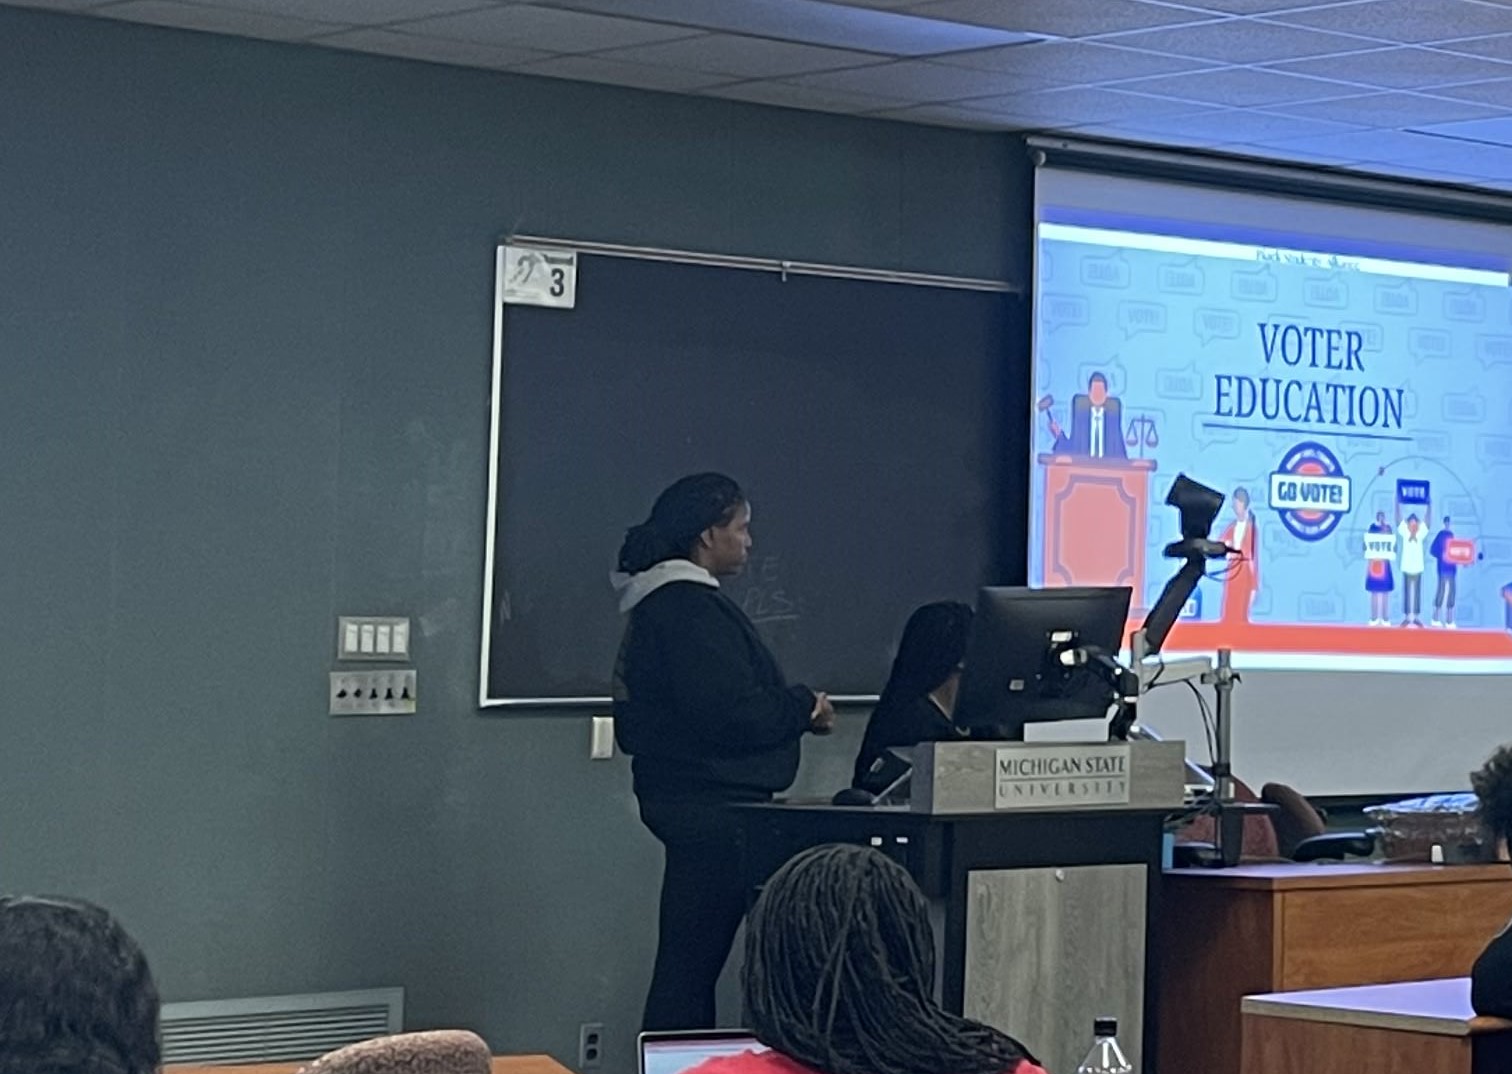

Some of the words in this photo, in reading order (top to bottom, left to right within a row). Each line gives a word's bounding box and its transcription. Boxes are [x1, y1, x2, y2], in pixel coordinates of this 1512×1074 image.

[549, 268, 565, 297] 3
[1257, 321, 1365, 373] VOTER
[1214, 375, 1405, 429] EDUCATION
[1278, 481, 1297, 502] GO
[1300, 481, 1343, 504] VOTE!
[999, 757, 1084, 776] MICHIGAN
[1086, 756, 1126, 774] STATE
[999, 780, 1127, 798] UNIVERSITY
